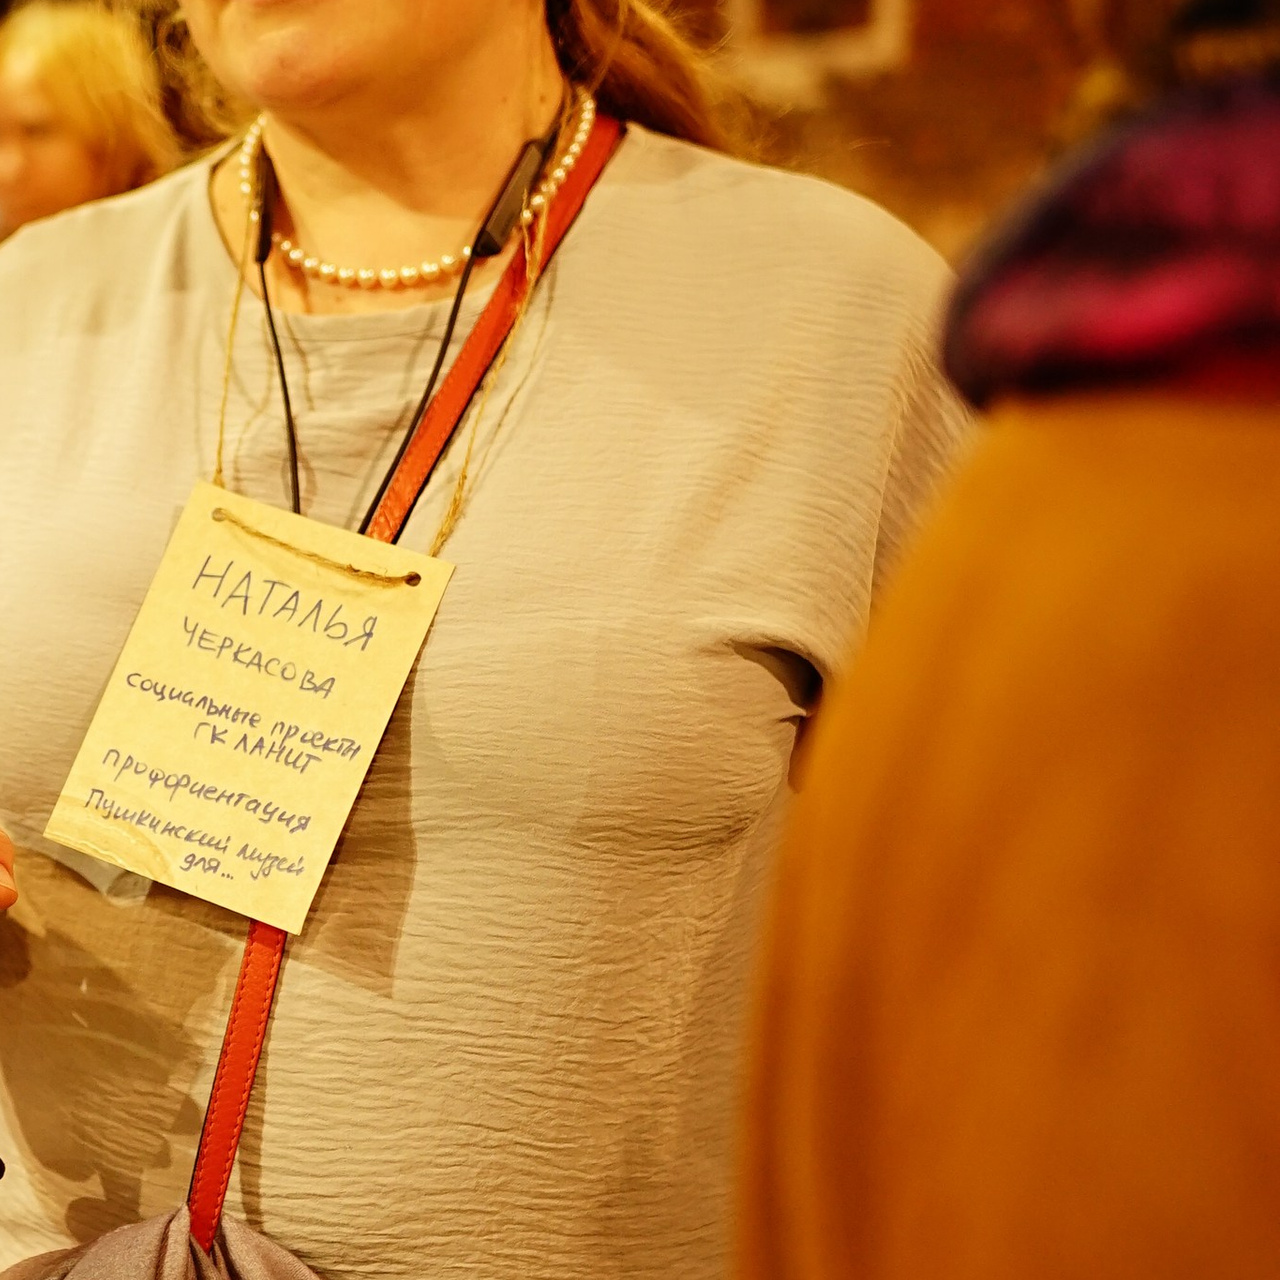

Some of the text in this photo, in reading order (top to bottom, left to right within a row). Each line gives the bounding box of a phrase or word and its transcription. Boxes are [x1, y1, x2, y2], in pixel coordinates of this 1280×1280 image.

[192, 554, 378, 652] НАТАЛЬЯ
[182, 616, 336, 700] ЧЕРКАСОВА
[126, 672, 261, 729] социальные
[193, 721, 322, 774] ГК ЛАНИТ
[83, 788, 231, 855] Пушкинский
[102, 748, 312, 833] профориентация
